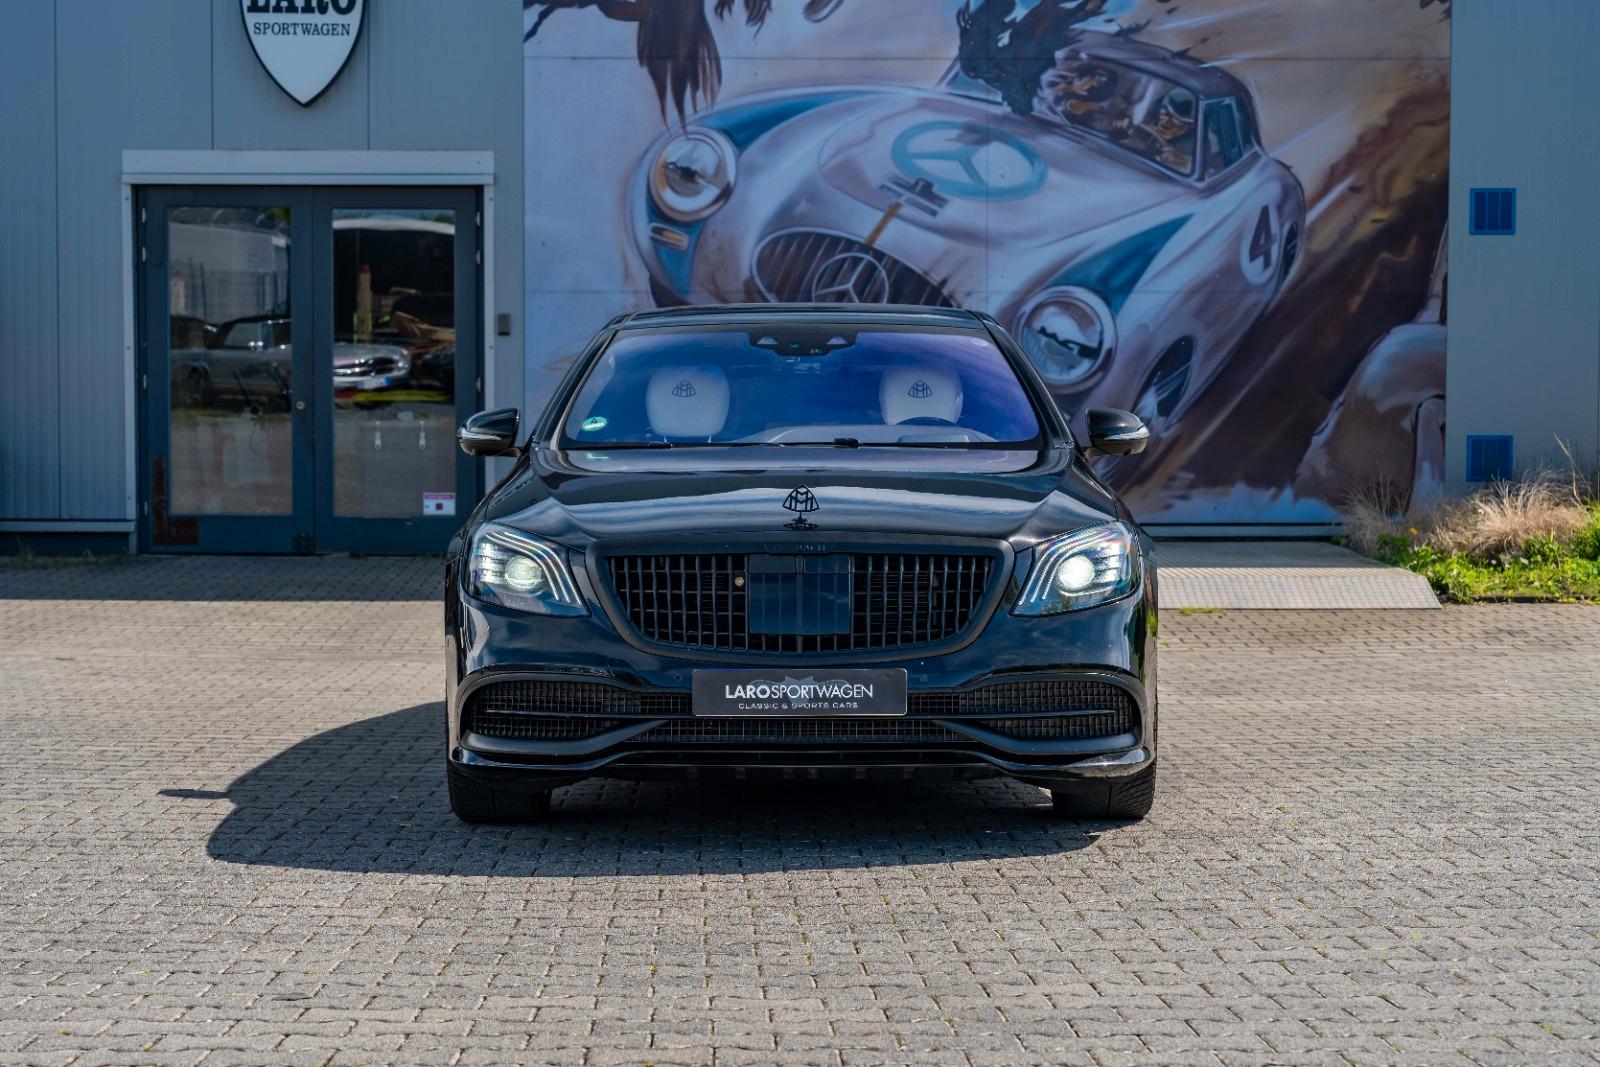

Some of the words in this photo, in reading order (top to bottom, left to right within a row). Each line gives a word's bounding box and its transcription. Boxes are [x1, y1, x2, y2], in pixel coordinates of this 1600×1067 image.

[253, 22, 351, 36] SPORTWAGEN
[1249, 204, 1277, 272] 4
[738, 702, 779, 710] CLASSIC
[791, 702, 829, 710] SPORTS
[832, 701, 859, 709] CARS
